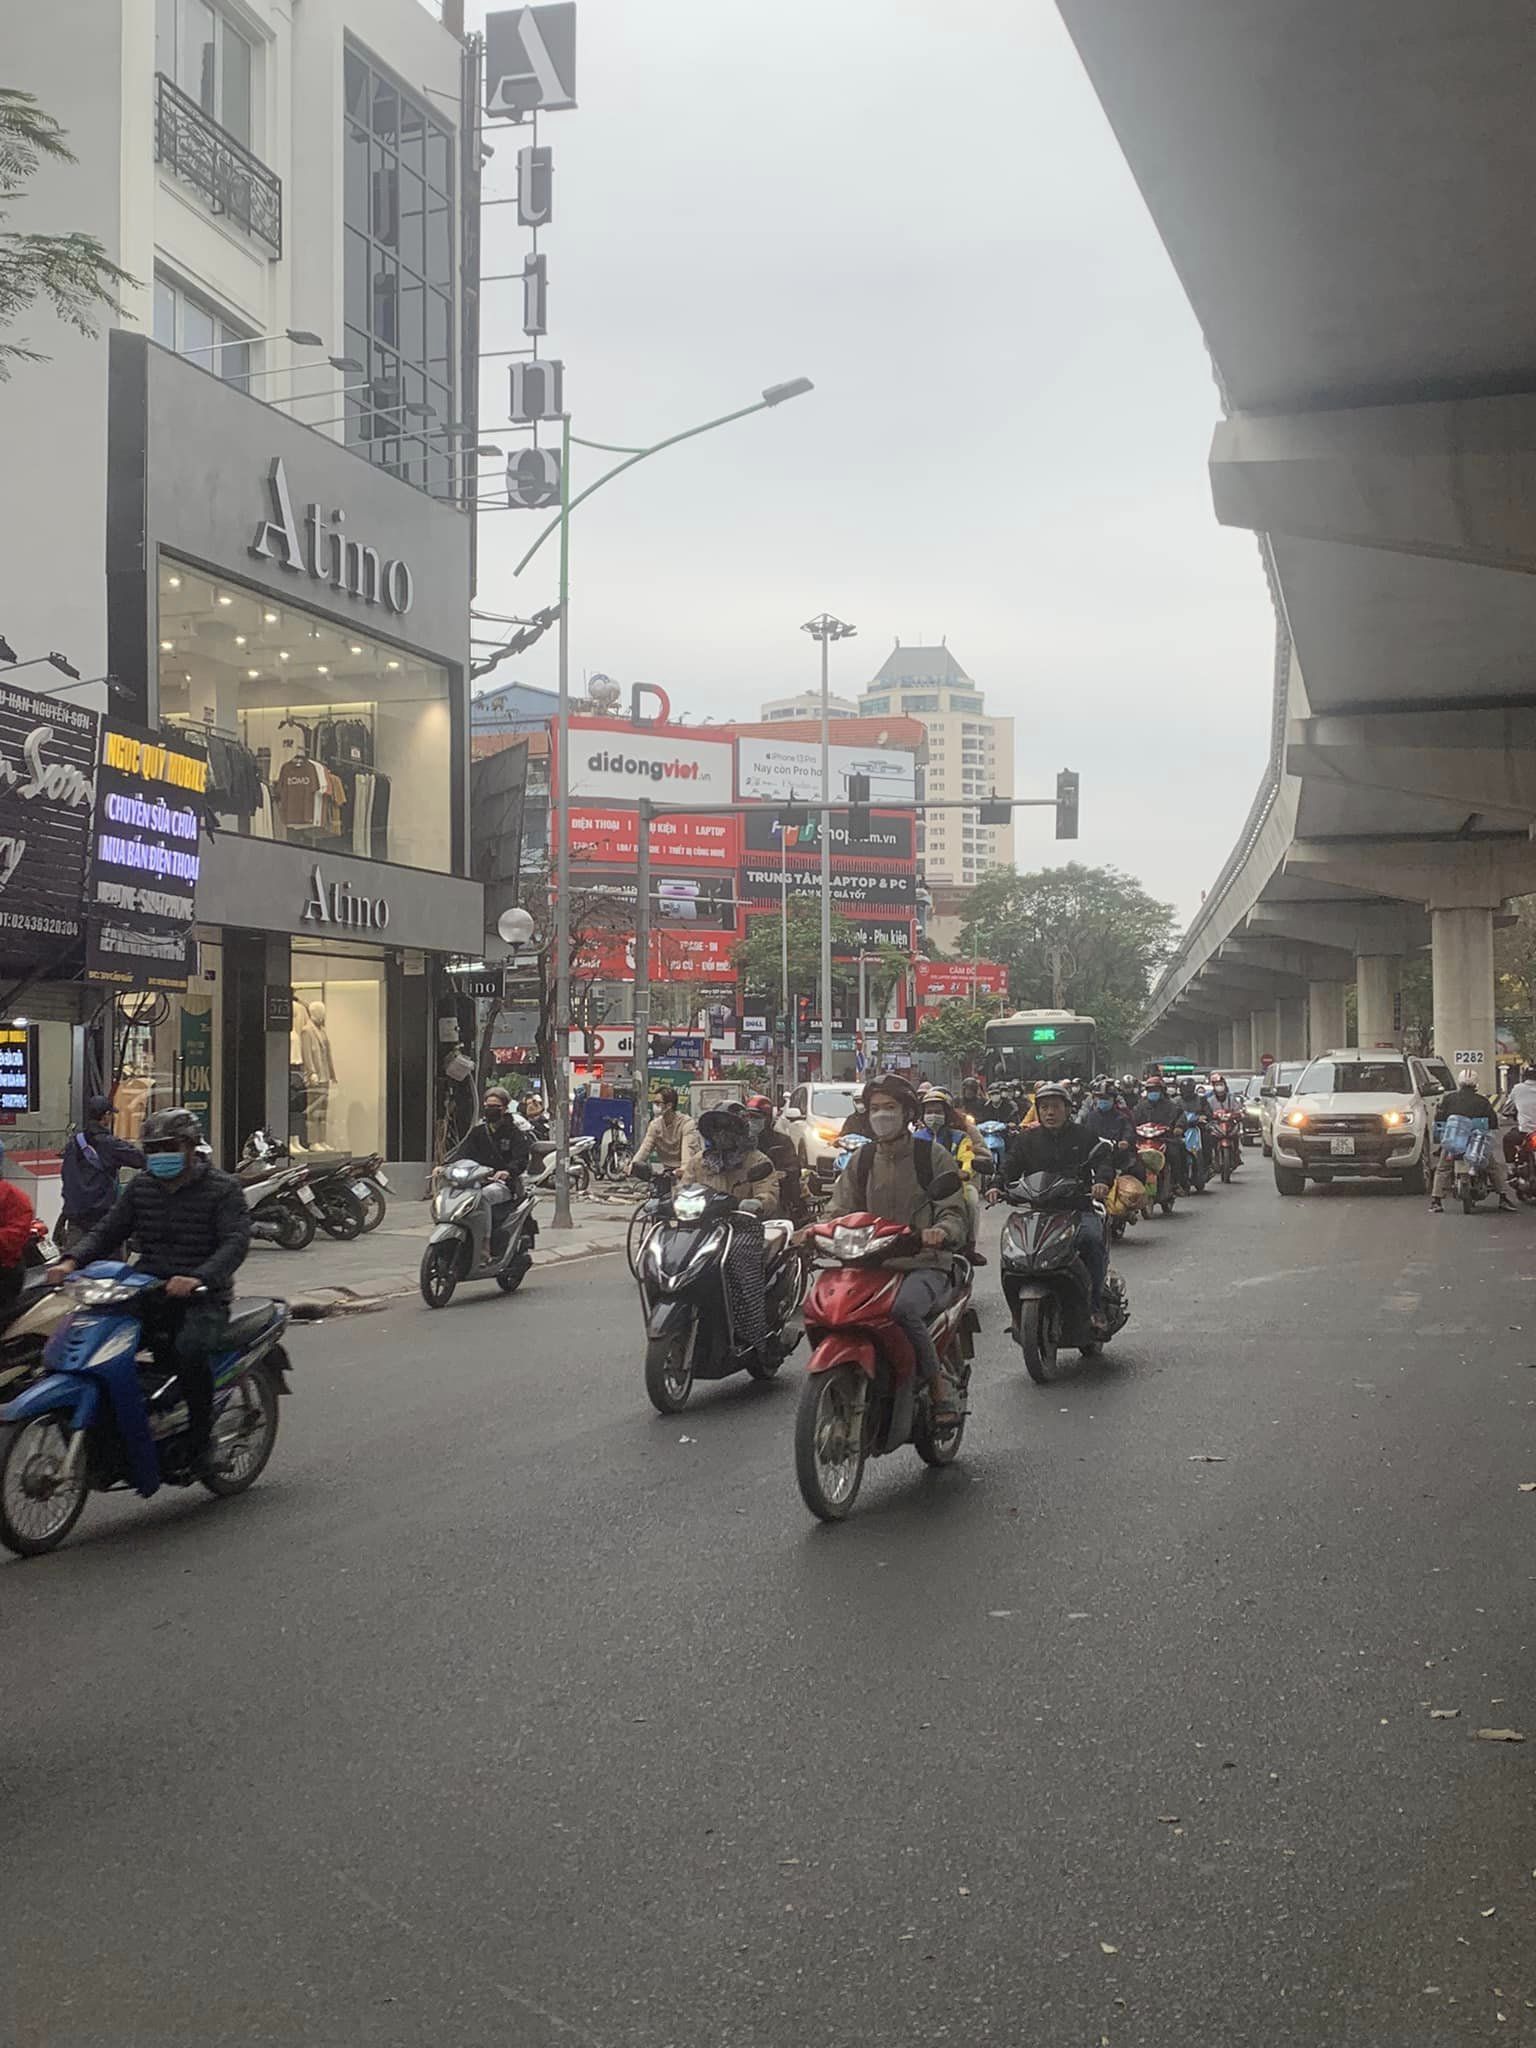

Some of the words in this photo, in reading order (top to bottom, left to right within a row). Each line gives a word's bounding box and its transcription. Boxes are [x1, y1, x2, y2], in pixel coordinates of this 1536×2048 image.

[247, 457, 414, 616] Atino
[164, 751, 208, 793] MOBILE
[753, 762, 771, 775] Nay
[793, 765, 809, 775] Pro
[98, 835, 125, 866] MUA
[747, 871, 792, 884] TRUNG
[794, 873, 823, 886] TÂM
[828, 876, 877, 889] APTOP
[890, 879, 907, 890] PC
[303, 864, 390, 931] Atino
[850, 888, 866, 899] TỐT
[890, 928, 908, 949] kiện
[1455, 1052, 1484, 1063] P282
